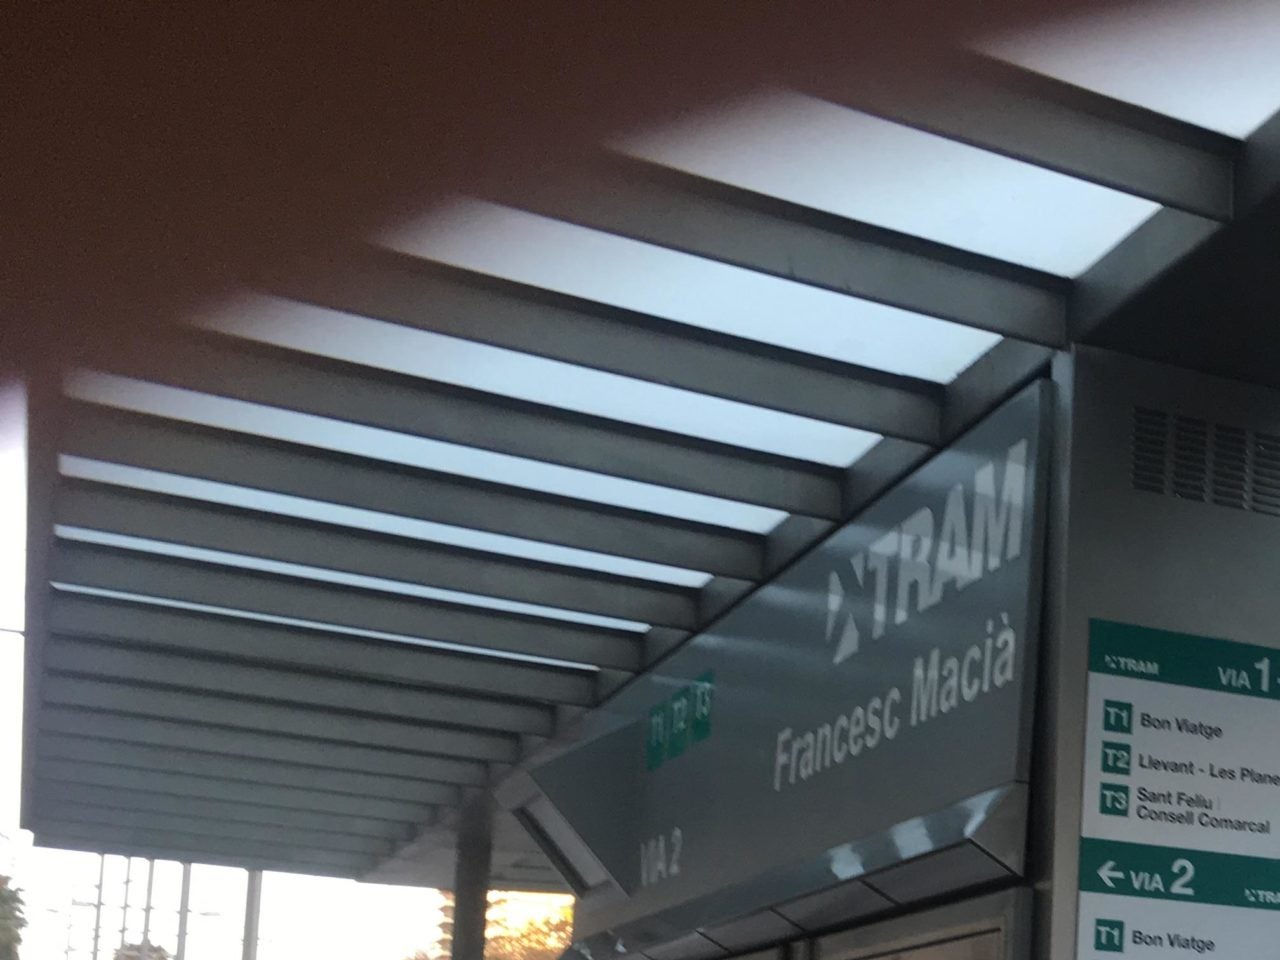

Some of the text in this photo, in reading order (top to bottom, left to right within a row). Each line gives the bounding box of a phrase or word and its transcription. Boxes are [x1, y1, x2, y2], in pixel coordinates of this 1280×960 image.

[869, 438, 1027, 640] TRAM
[1118, 657, 1160, 676] TRAM
[1218, 657, 1271, 692] VIA 1
[774, 612, 1016, 792] Francesc Macià
[1106, 706, 1129, 728] T1
[1140, 712, 1223, 740] Bon Viatge
[1104, 749, 1129, 769] T2
[1138, 753, 1195, 776] Llevant
[1209, 763, 1236, 781] Les
[1103, 789, 1128, 810] T3
[1136, 787, 1213, 810] Sant Feliu
[1136, 806, 1271, 834] Consell Comarcal
[1130, 858, 1195, 895] VIA 2
[1097, 925, 1121, 946] T1
[1132, 930, 1215, 953] Bon Viatge
